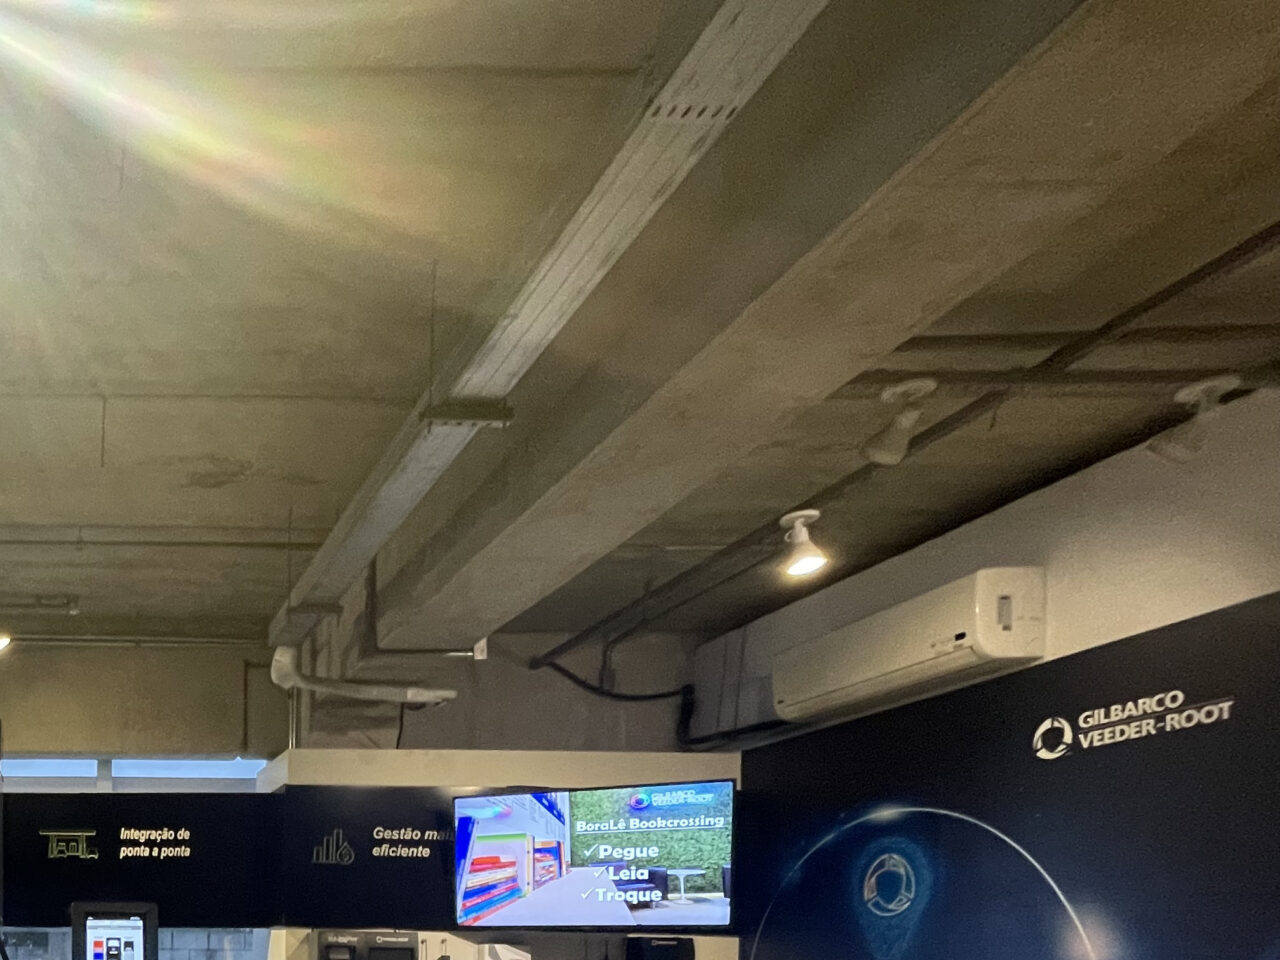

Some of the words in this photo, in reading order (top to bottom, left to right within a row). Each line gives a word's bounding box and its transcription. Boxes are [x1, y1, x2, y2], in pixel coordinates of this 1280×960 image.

[1078, 690, 1185, 728] GILBARCO
[1078, 701, 1234, 749] VEEDER-ROOT
[577, 818, 627, 832] BoraLê
[630, 814, 725, 829] Bookcrossing
[120, 827, 175, 843] Integração
[177, 827, 191, 840] de
[373, 826, 421, 840] Gestão
[119, 845, 150, 859] ponta
[152, 847, 159, 857] a
[160, 845, 191, 860] ponta
[372, 844, 431, 858] eficiente
[598, 844, 660, 860] Pegue
[608, 866, 650, 881] Leia
[596, 888, 663, 904] Troque
